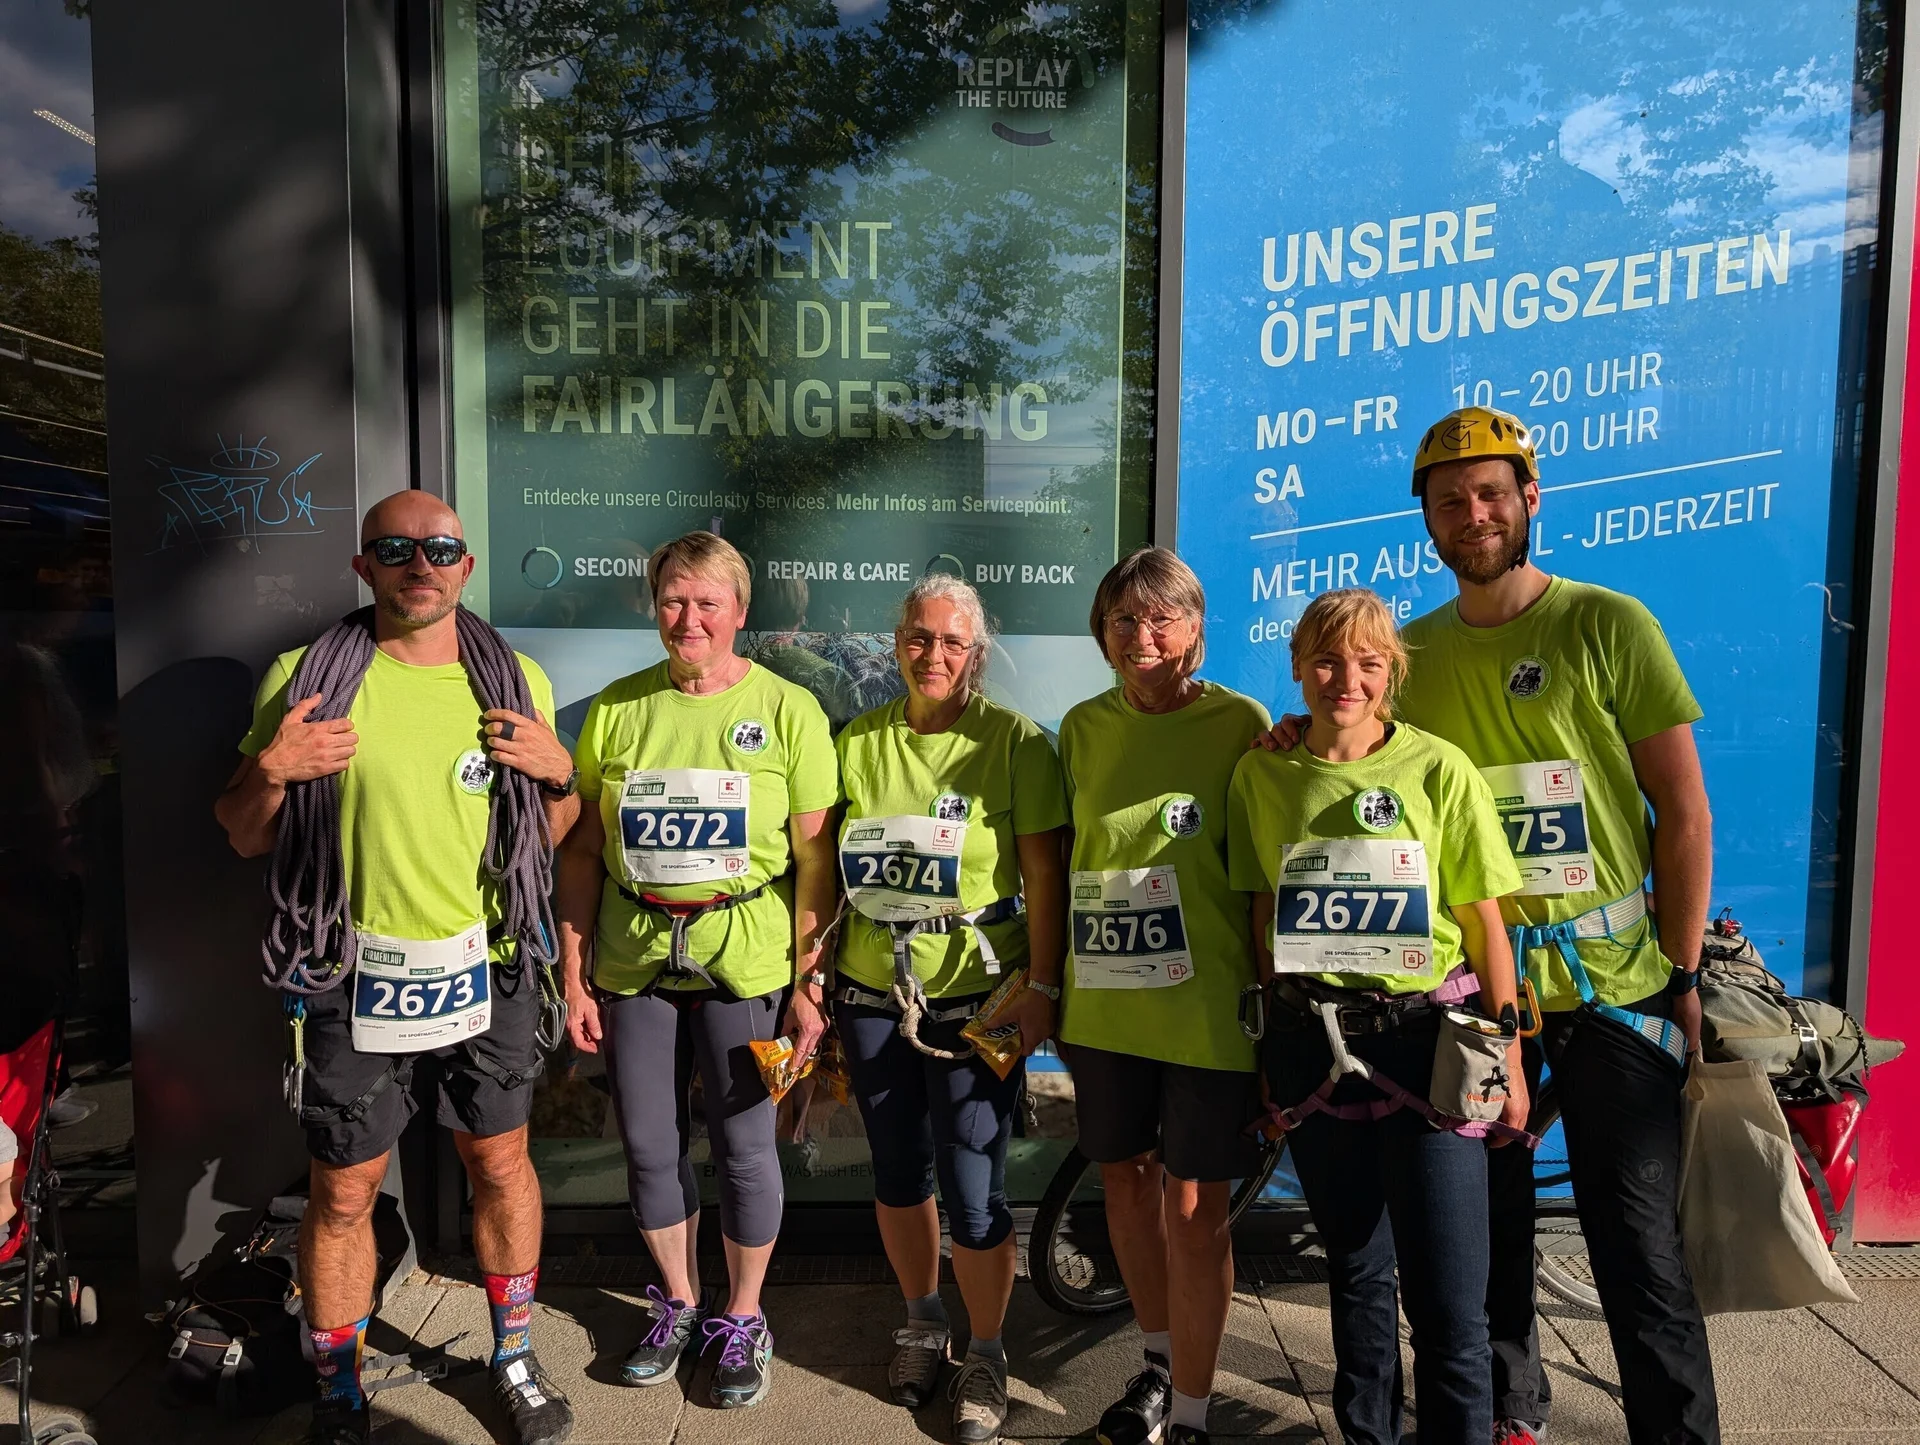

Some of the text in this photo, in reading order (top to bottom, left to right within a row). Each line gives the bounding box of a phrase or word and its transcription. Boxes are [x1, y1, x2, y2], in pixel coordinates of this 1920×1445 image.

[957, 58, 1071, 88] REPLAY
[956, 90, 1067, 109] THE FUTURE
[521, 215, 892, 284] EQUIPMENT
[1263, 203, 1497, 292] UNSERE
[1261, 230, 1791, 368] ÖFFNUNGSZEITEN
[522, 296, 892, 360] GEHT IN DIE
[1529, 367, 1571, 407] 20
[1584, 352, 1663, 398] UHR
[522, 364, 1049, 442] FAIRLÄNGERUNG
[1256, 407, 1316, 450] MO
[1354, 395, 1398, 436] FR
[1582, 407, 1660, 452] UHR
[523, 487, 1073, 519] Entdecke unsere Circularity Services. Mehr Infos am Servicepoint.
[1254, 467, 1305, 505] SA
[1252, 554, 1359, 604] MEHR
[1581, 482, 1780, 549] JEDERZEIT
[768, 561, 910, 583] REPAIR & CARE
[976, 564, 1075, 584] BUY BACK
[637, 812, 730, 847] 2672
[1500, 811, 1566, 852] 75
[858, 855, 943, 893] 2674
[1287, 858, 1327, 871] FIRMENLAUF
[1295, 890, 1409, 931] 2677
[1085, 914, 1167, 952] 2676
[364, 950, 403, 965] FIRMENLAUF
[371, 972, 474, 1016] 2673
[783, 1164, 811, 1178] WAS
